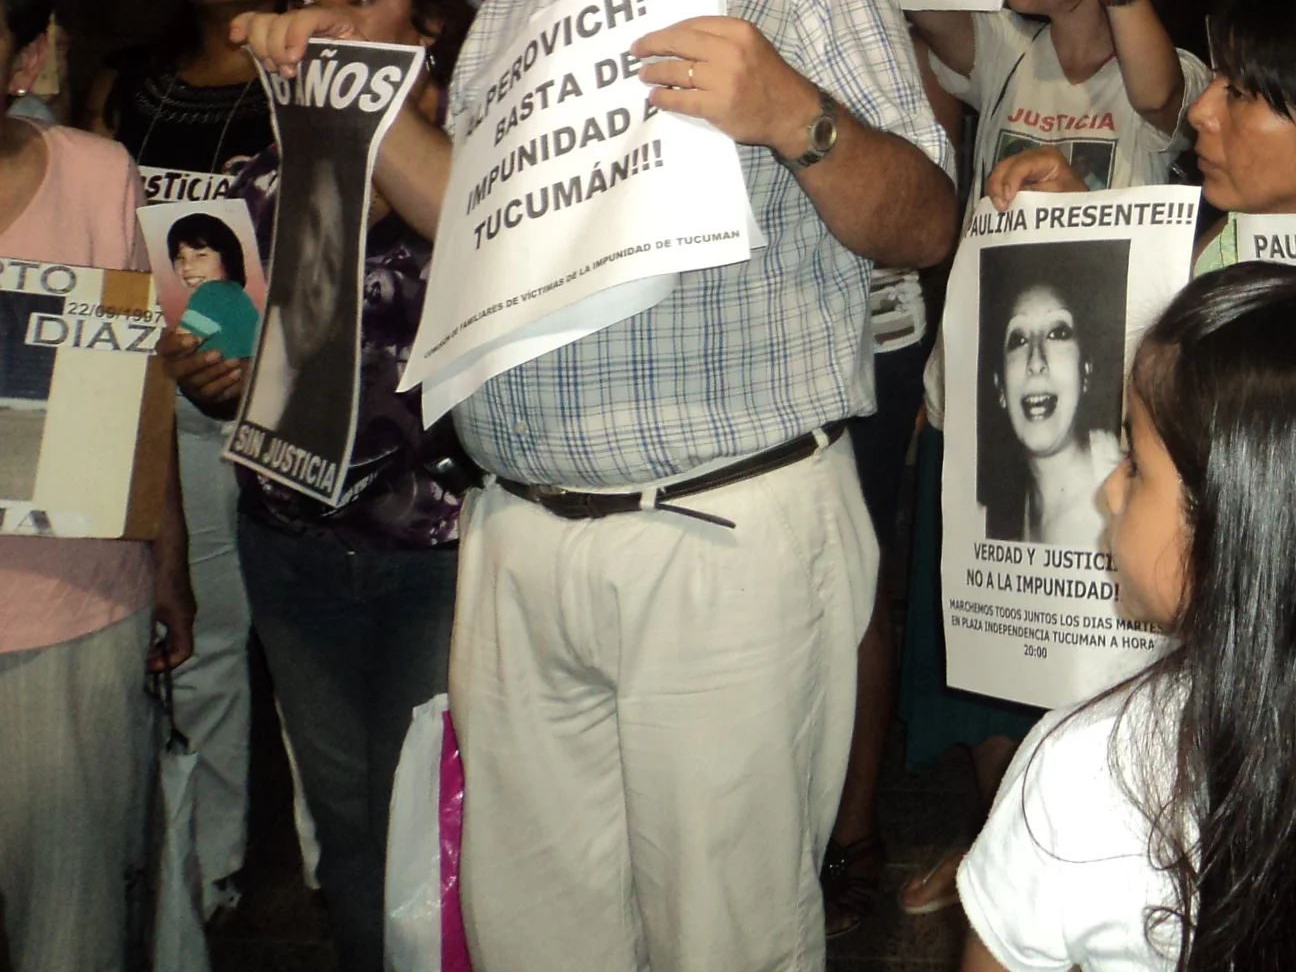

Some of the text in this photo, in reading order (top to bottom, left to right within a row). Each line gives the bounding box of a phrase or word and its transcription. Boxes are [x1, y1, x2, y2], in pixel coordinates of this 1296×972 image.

[494, 72, 584, 147] BASTA
[1007, 107, 1117, 133] JUSTICIA
[466, 107, 631, 216] IMPUNIDAD
[474, 139, 664, 249] TUCUMÁN!!!
[964, 202, 1195, 238] PAULINA PRESENTE!!!
[0, 260, 78, 295] TO
[505, 296, 519, 308] DE
[566, 271, 577, 283] DE
[579, 264, 591, 276] LA
[592, 243, 652, 270] IMPUNIDAD
[655, 238, 672, 250] DE
[32, 314, 157, 354] DIAZ
[233, 425, 337, 494] SIN JUSTICIA
[974, 542, 1118, 572] VERDAD Y JUSTICI
[966, 568, 1120, 602] NO A LA IMPUNIDAD!
[949, 598, 994, 617] MARCHEMOS
[995, 605, 1022, 620] TODOS
[1023, 609, 1058, 626] JUNTOS
[1060, 614, 1080, 627] LOS
[1083, 616, 1112, 630] DIAS
[951, 615, 1155, 650] EN PLAZA INDEPENDENCIA TUCUMAN A HORA
[1023, 644, 1048, 659] 20:00
